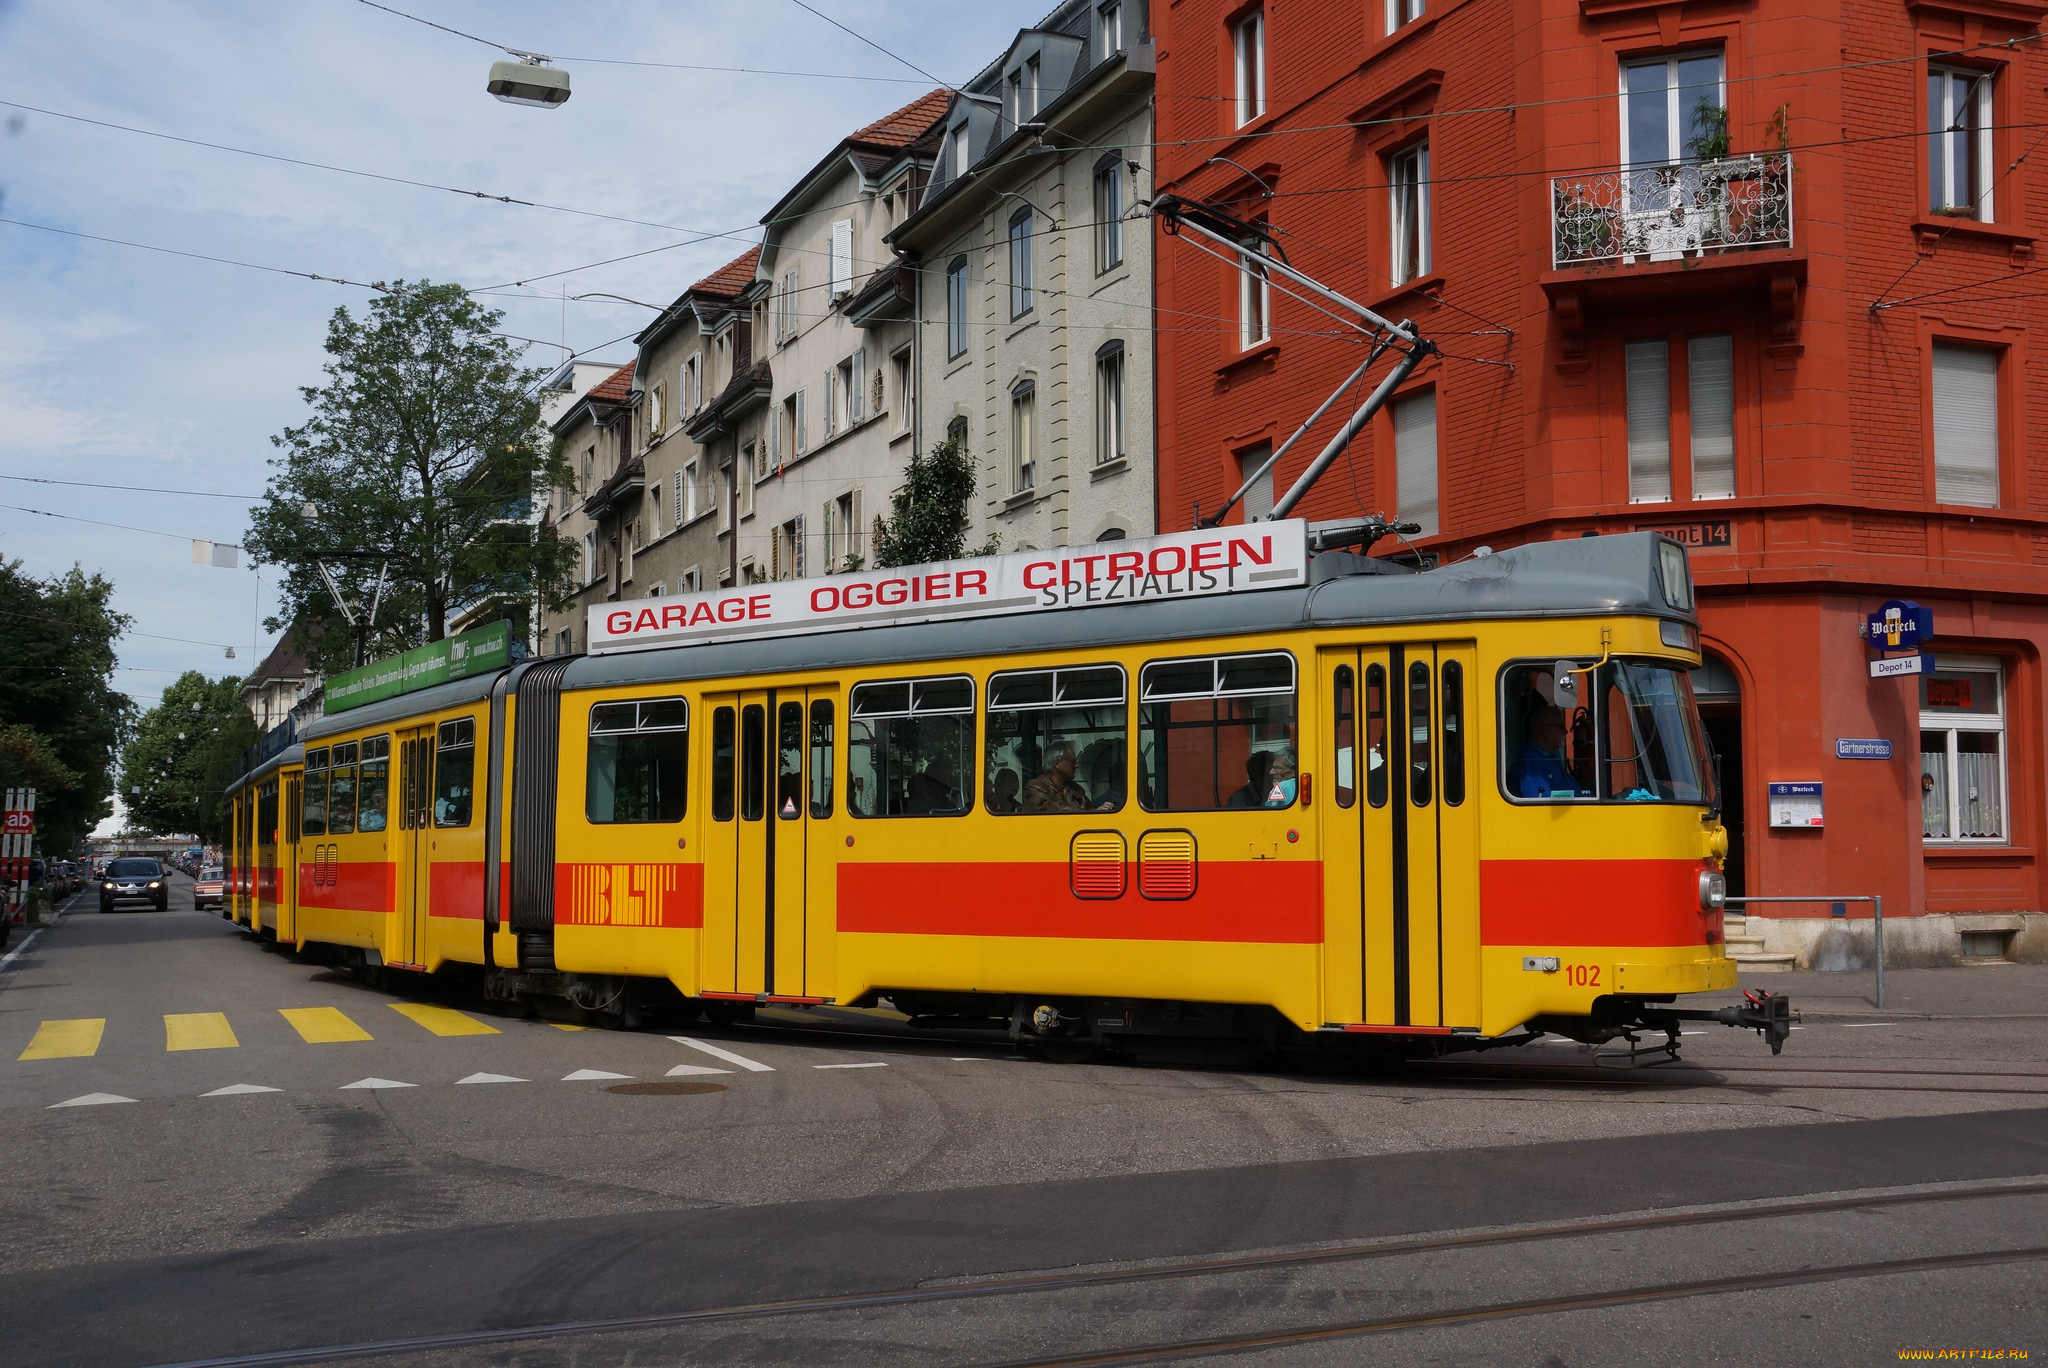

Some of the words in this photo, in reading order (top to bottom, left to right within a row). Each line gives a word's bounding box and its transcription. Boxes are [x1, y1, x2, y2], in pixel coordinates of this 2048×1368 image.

[1705, 524, 1727, 543] 14
[607, 594, 771, 635] GARAGE
[811, 570, 987, 612] OGGIER
[1023, 536, 1272, 590] CITROEN
[1042, 562, 1242, 606] SPEZIALIST
[1871, 619, 1916, 638] Warteck
[1878, 662, 1902, 674] Depot
[1904, 661, 1912, 669] 14
[1840, 740, 1890, 754] Gärtnerstrasse
[8, 811, 30, 827] ab
[1565, 965, 1600, 986] 102
